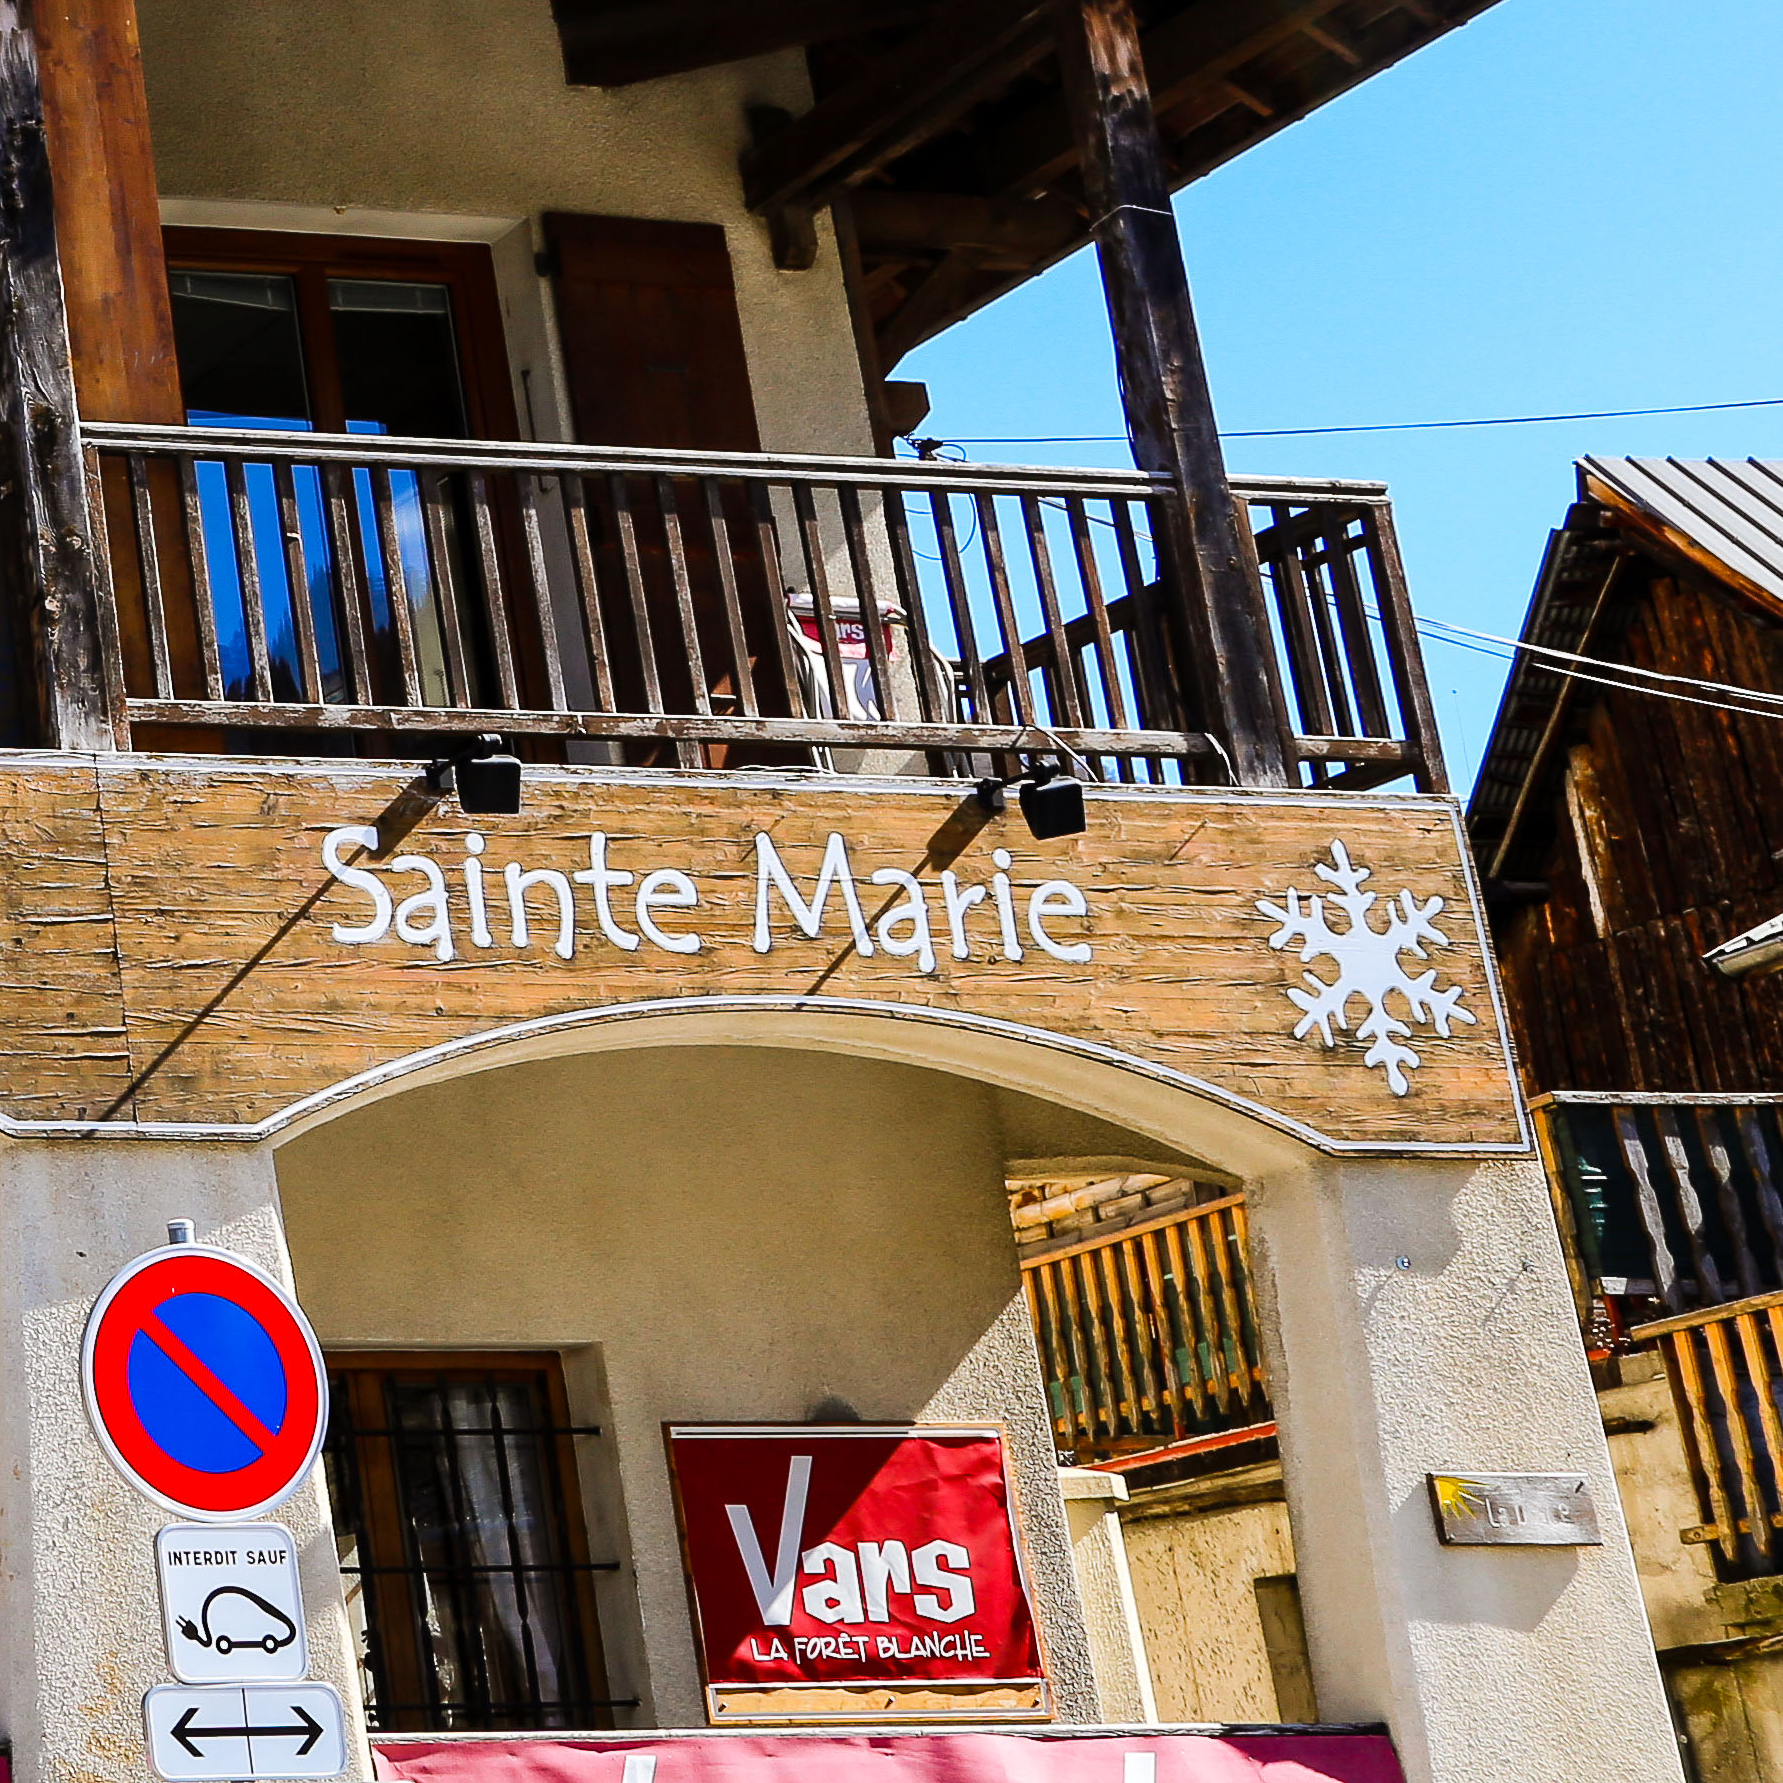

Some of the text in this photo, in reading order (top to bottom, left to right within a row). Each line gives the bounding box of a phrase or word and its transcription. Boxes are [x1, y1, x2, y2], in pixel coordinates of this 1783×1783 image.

[319, 824, 1094, 975] Sainte Marie
[168, 1549, 287, 1566] INTERDIT SAUF
[724, 1455, 976, 1627] Vars
[750, 1630, 991, 1665] LA FORÊT BLANCHE
